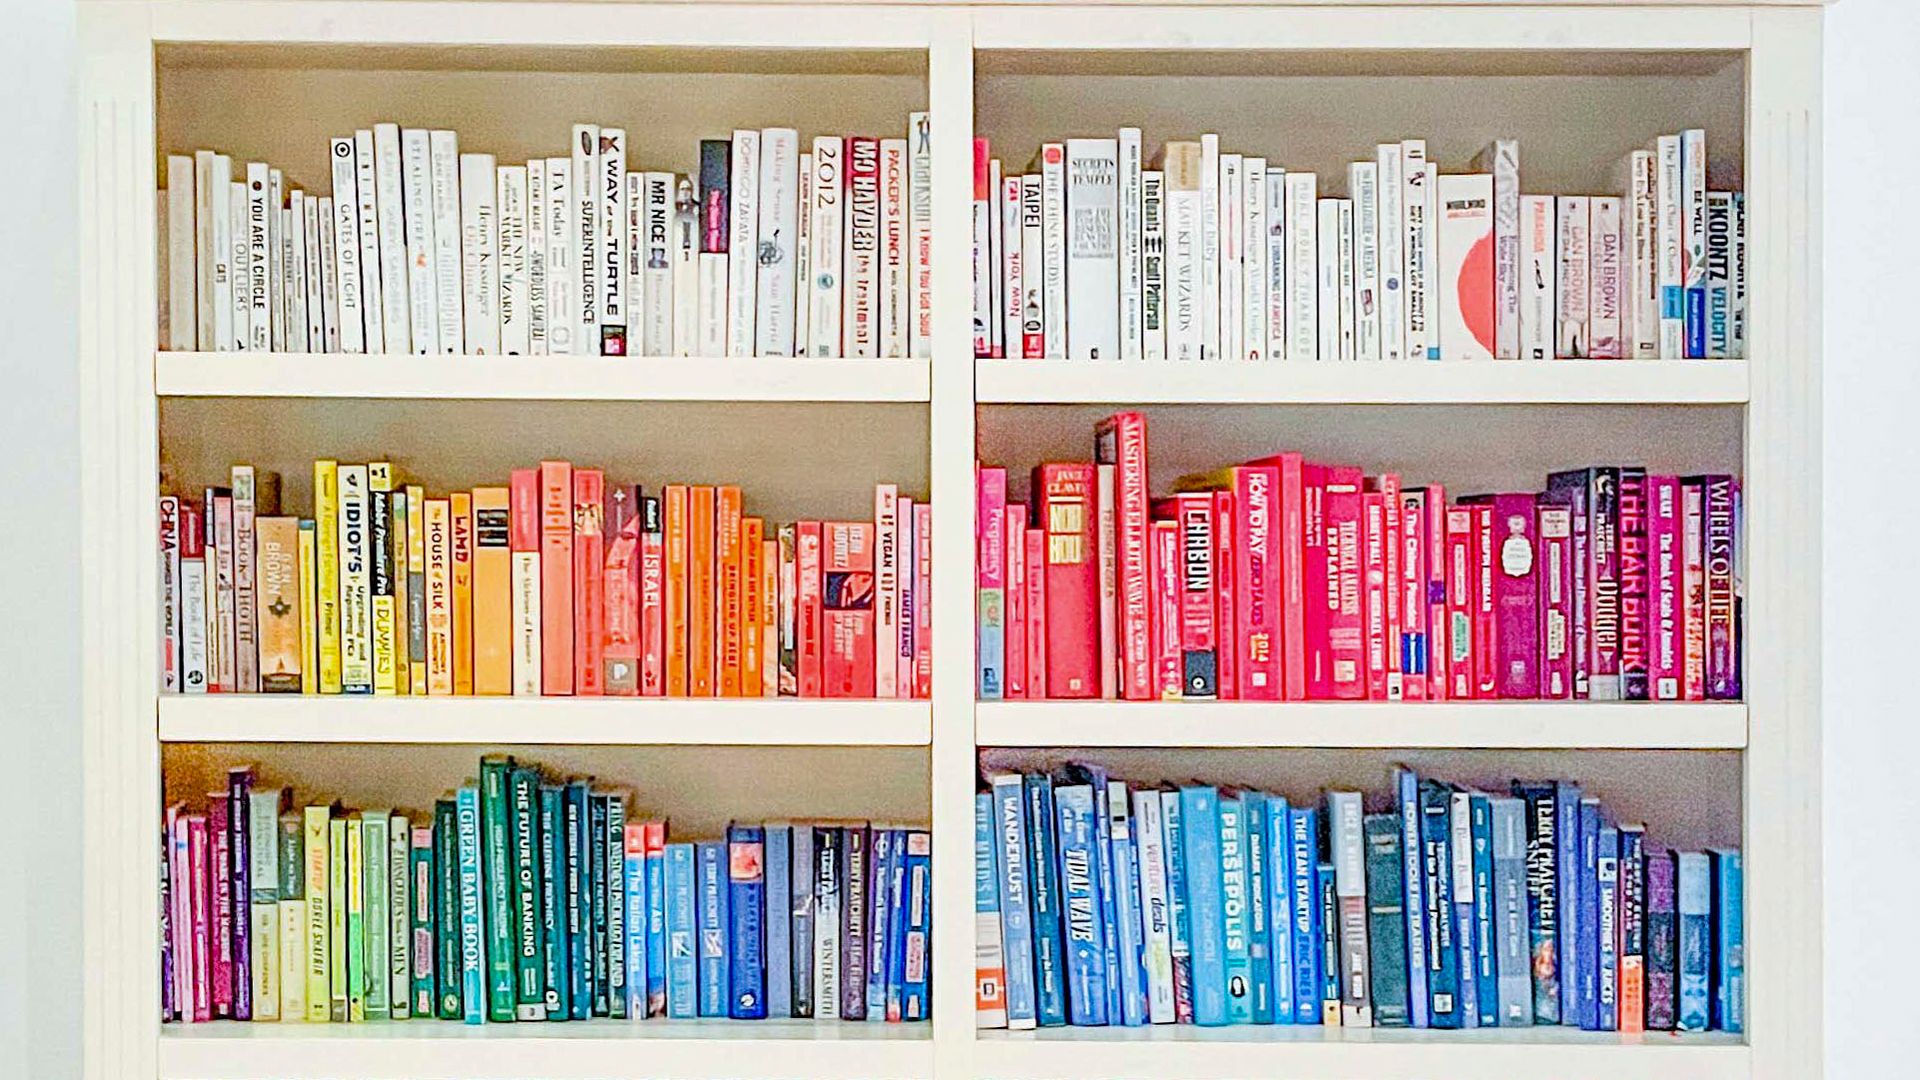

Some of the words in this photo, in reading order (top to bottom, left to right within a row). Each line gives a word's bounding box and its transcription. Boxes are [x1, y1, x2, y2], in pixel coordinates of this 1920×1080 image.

[411, 139, 422, 205] STEALING
[739, 137, 750, 197] DOMINGO
[772, 137, 784, 182] Making
[852, 140, 877, 172] MO
[607, 160, 617, 203] WAY
[651, 181, 665, 204] MR
[818, 147, 836, 209] 2012
[888, 150, 900, 216] PACKER'S
[1046, 171, 1058, 194] THE
[1145, 180, 1159, 196] The
[1694, 191, 1703, 204] BE
[252, 198, 263, 221] YOU
[341, 204, 354, 243] GATES
[478, 205, 491, 245] Henry
[553, 199, 566, 237] Today
[651, 209, 665, 242] NICE
[738, 202, 749, 242] ZAPATA
[852, 177, 876, 250] HAYDER
[1024, 183, 1040, 227] TAIPEI
[1047, 198, 1058, 239] CHINA
[1145, 198, 1159, 231] Quants
[1694, 207, 1703, 236] WELL
[253, 226, 264, 249] ARE
[413, 213, 423, 241] FIRE
[889, 220, 900, 265] LUNCH
[1178, 199, 1192, 260] MARKET
[1499, 236, 1508, 258] Wide
[1571, 226, 1583, 254] DAN
[1709, 209, 1728, 280] KOONTZ
[253, 255, 264, 263] A
[343, 250, 353, 266] OF
[582, 201, 594, 325] SUPERINTELLIGENCE
[857, 255, 869, 272] the
[1010, 252, 1019, 281] York
[1048, 243, 1060, 282] STUDY
[1146, 256, 1160, 281] Scott
[1603, 234, 1615, 263] DAN
[216, 264, 226, 283] CATS
[235, 244, 247, 312] OUTLIERS
[253, 266, 265, 308] CIRCLE
[344, 272, 355, 308] LIGHT
[478, 253, 491, 316] Kissinger
[607, 238, 618, 315] TURTLE
[1498, 263, 1508, 283] Sky
[1572, 258, 1584, 312] BROWN
[1603, 267, 1616, 319] BROWN
[856, 280, 869, 343] treatment
[1009, 286, 1020, 317] New
[1146, 284, 1161, 330] Patterson
[1179, 265, 1192, 331] WIZARDS
[770, 305, 780, 343] Harris
[1711, 287, 1727, 353] VELOCITY
[374, 492, 385, 525] Adobe
[1386, 480, 1398, 526] crucial
[1621, 482, 1645, 532] THE
[1710, 481, 1729, 552] WHEELS
[346, 502, 361, 572] IDIOT'S
[431, 522, 442, 569] HOUSE
[987, 508, 1002, 579] Pregnancy
[1340, 521, 1357, 570] TECHNICAL
[1406, 514, 1417, 535] The
[1659, 533, 1673, 551] The
[265, 542, 280, 595] BROWN
[281, 554, 291, 582] DAN
[374, 527, 387, 574] Premiere
[883, 532, 893, 567] VEGAN
[1186, 510, 1211, 592] CHABON
[1328, 528, 1338, 609] EXPLAINED
[1621, 537, 1645, 594] BAR
[1659, 553, 1673, 578] Book
[377, 577, 388, 595] Pro
[645, 554, 660, 609] ISRAEL
[727, 565, 737, 619] BRINGING
[1388, 530, 1399, 619] conversations
[1660, 580, 1673, 591] of
[1710, 558, 1729, 586] OF
[356, 586, 366, 638] Upgrading
[432, 582, 443, 609] SILK
[901, 589, 911, 618] JAMES
[1342, 573, 1359, 615] ANALYSIS
[1592, 580, 1618, 648] Dodger
[1710, 590, 1730, 624] LIFE
[378, 609, 390, 674] DUMMIES
[728, 623, 736, 637] UP
[901, 622, 911, 657] FRANCO
[1622, 598, 1646, 672] BOOK
[1661, 619, 1674, 628] &
[359, 643, 367, 661] and
[1258, 633, 1269, 662] 2014
[517, 782, 528, 808] THE
[461, 811, 474, 871] GREEN
[519, 812, 530, 866] FUTURE
[1295, 817, 1307, 840] THE
[1406, 801, 1417, 847] POWER
[1537, 797, 1554, 845] TERRY
[849, 851, 859, 881] TERRY
[1004, 797, 1022, 905] WANDERLUST
[1065, 849, 1088, 893] TIDAL
[1147, 843, 1161, 897] venture
[1296, 843, 1308, 876] LEAN
[1407, 850, 1419, 891] TOOLS
[1437, 842, 1448, 896] TECHNICAL
[1527, 840, 1539, 896] SNUFF
[394, 857, 404, 916] DANGEROUS
[463, 873, 476, 916] BABY
[521, 870, 531, 888] OF
[630, 870, 640, 891] The
[1221, 812, 1242, 951] PERSEPOLIS
[1538, 847, 1555, 935] PRATCHETT
[522, 892, 534, 956] BANKING
[630, 895, 641, 933] Italian
[651, 909, 662, 933] Asia
[849, 882, 861, 936] PRATCHETT
[1069, 896, 1092, 942] WAVE
[1150, 898, 1166, 933] deals
[1297, 879, 1309, 933] STARTUP
[1439, 899, 1450, 947] ANALYSIS
[394, 946, 405, 975] MEN
[465, 924, 479, 971] BOOK
[630, 936, 641, 972] Lakes
[1298, 935, 1310, 964] ERIC
[1411, 914, 1422, 968] TRADERS
[821, 938, 833, 1015] WINTERSMITH
[1299, 967, 1310, 996] RIES
